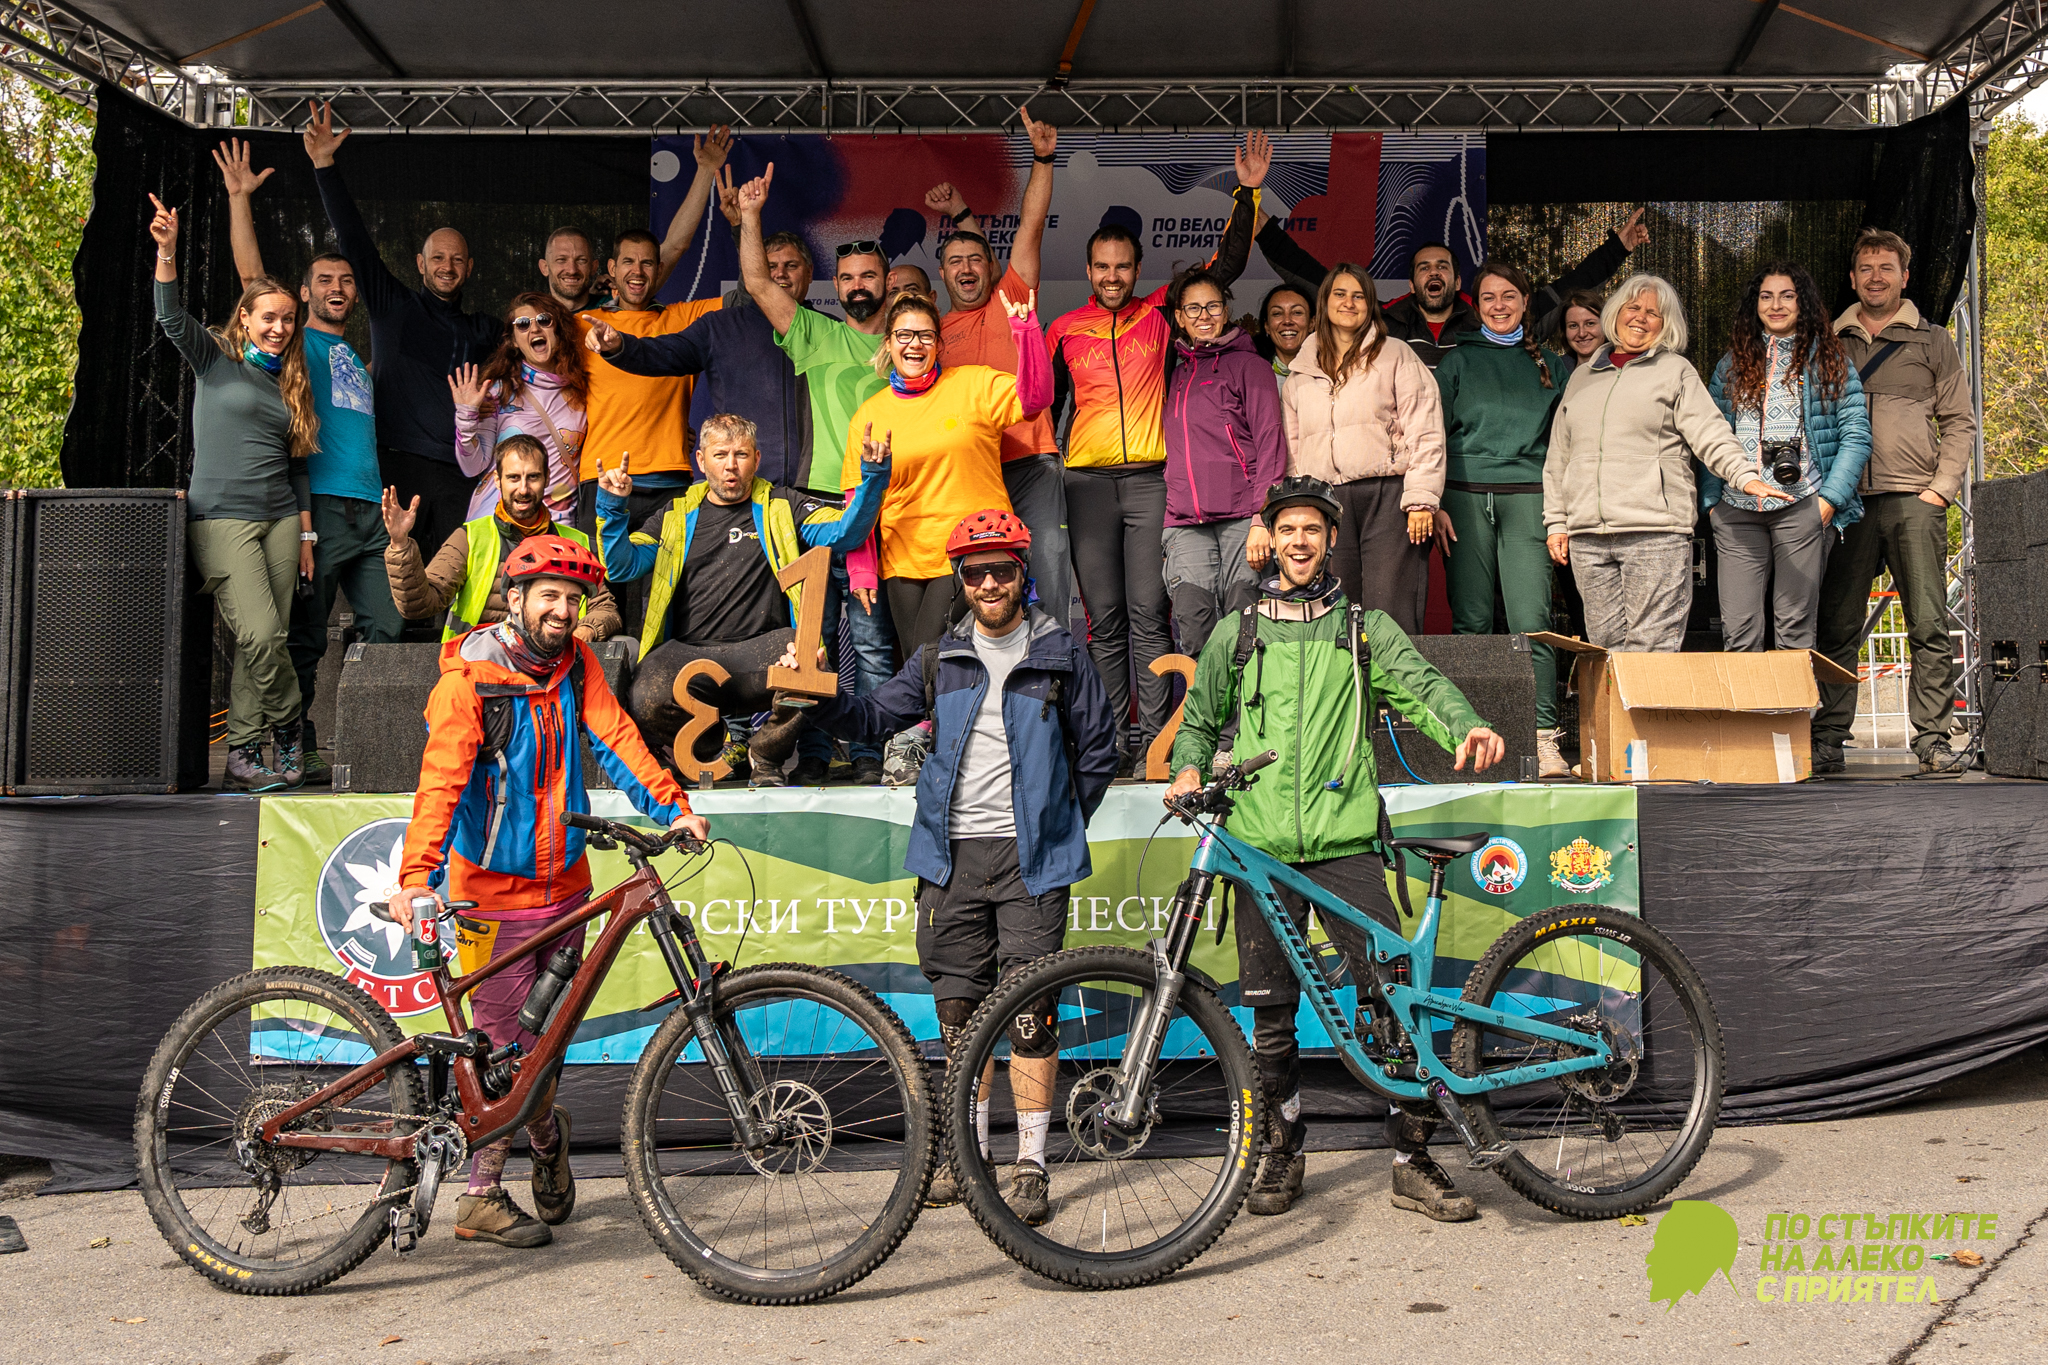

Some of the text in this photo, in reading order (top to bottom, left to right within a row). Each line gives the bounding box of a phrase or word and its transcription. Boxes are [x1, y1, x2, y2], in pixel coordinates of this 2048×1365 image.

[1152, 218, 1176, 231] ПО
[1152, 234, 1225, 247] С ПРИЯТ
[766, 545, 838, 697] 1
[1489, 883, 1511, 893] БТС
[1535, 917, 1597, 939] MAXXIS
[160, 1067, 181, 1109] DT SWISS
[1237, 1088, 1253, 1170] MAXXIS
[642, 1190, 670, 1236] BUTCHER
[188, 1243, 253, 1280] MAXXIS
